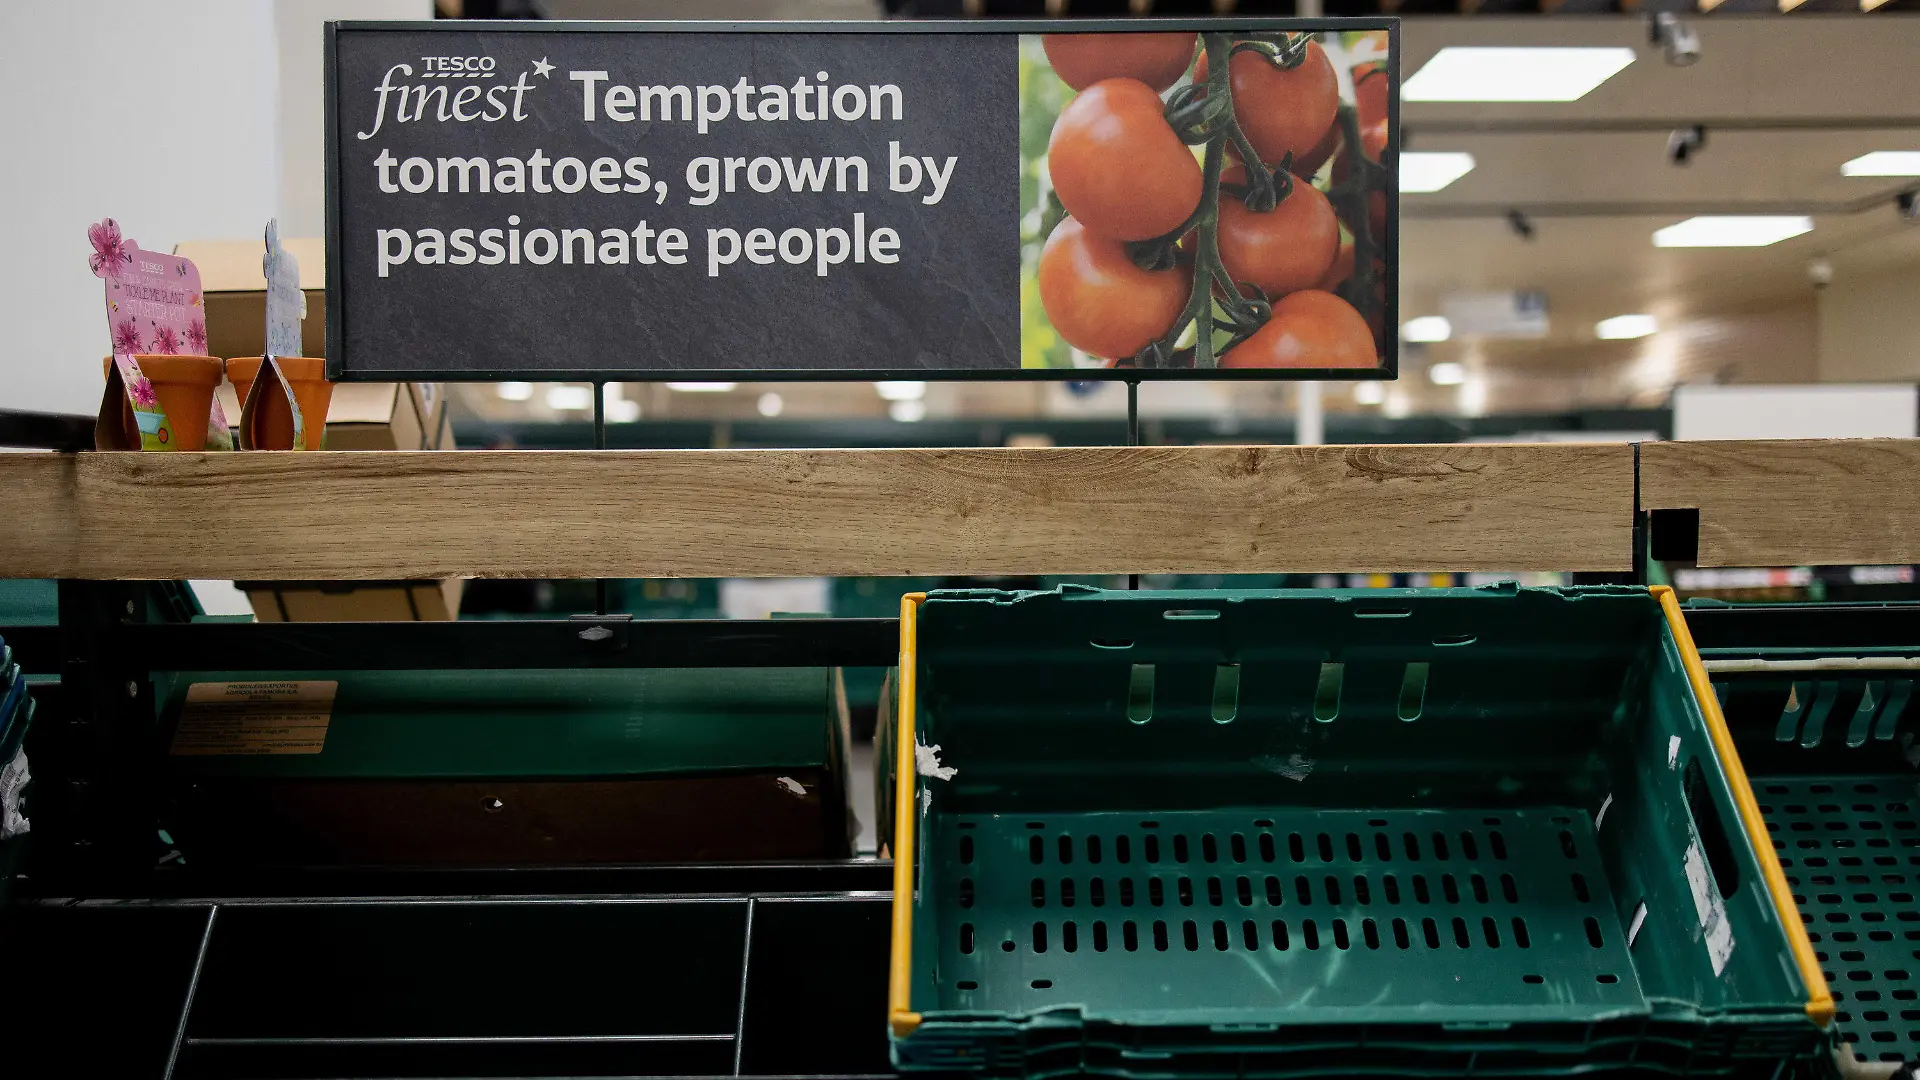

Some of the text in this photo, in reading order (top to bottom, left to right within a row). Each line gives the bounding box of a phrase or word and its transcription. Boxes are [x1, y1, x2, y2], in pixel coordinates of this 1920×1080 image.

[421, 56, 496, 72] TESCO
[357, 63, 903, 140] finest Temptation
[373, 140, 958, 206] tomatoes, grown by
[140, 260, 164, 272] TESCO
[376, 212, 901, 278] passionate people
